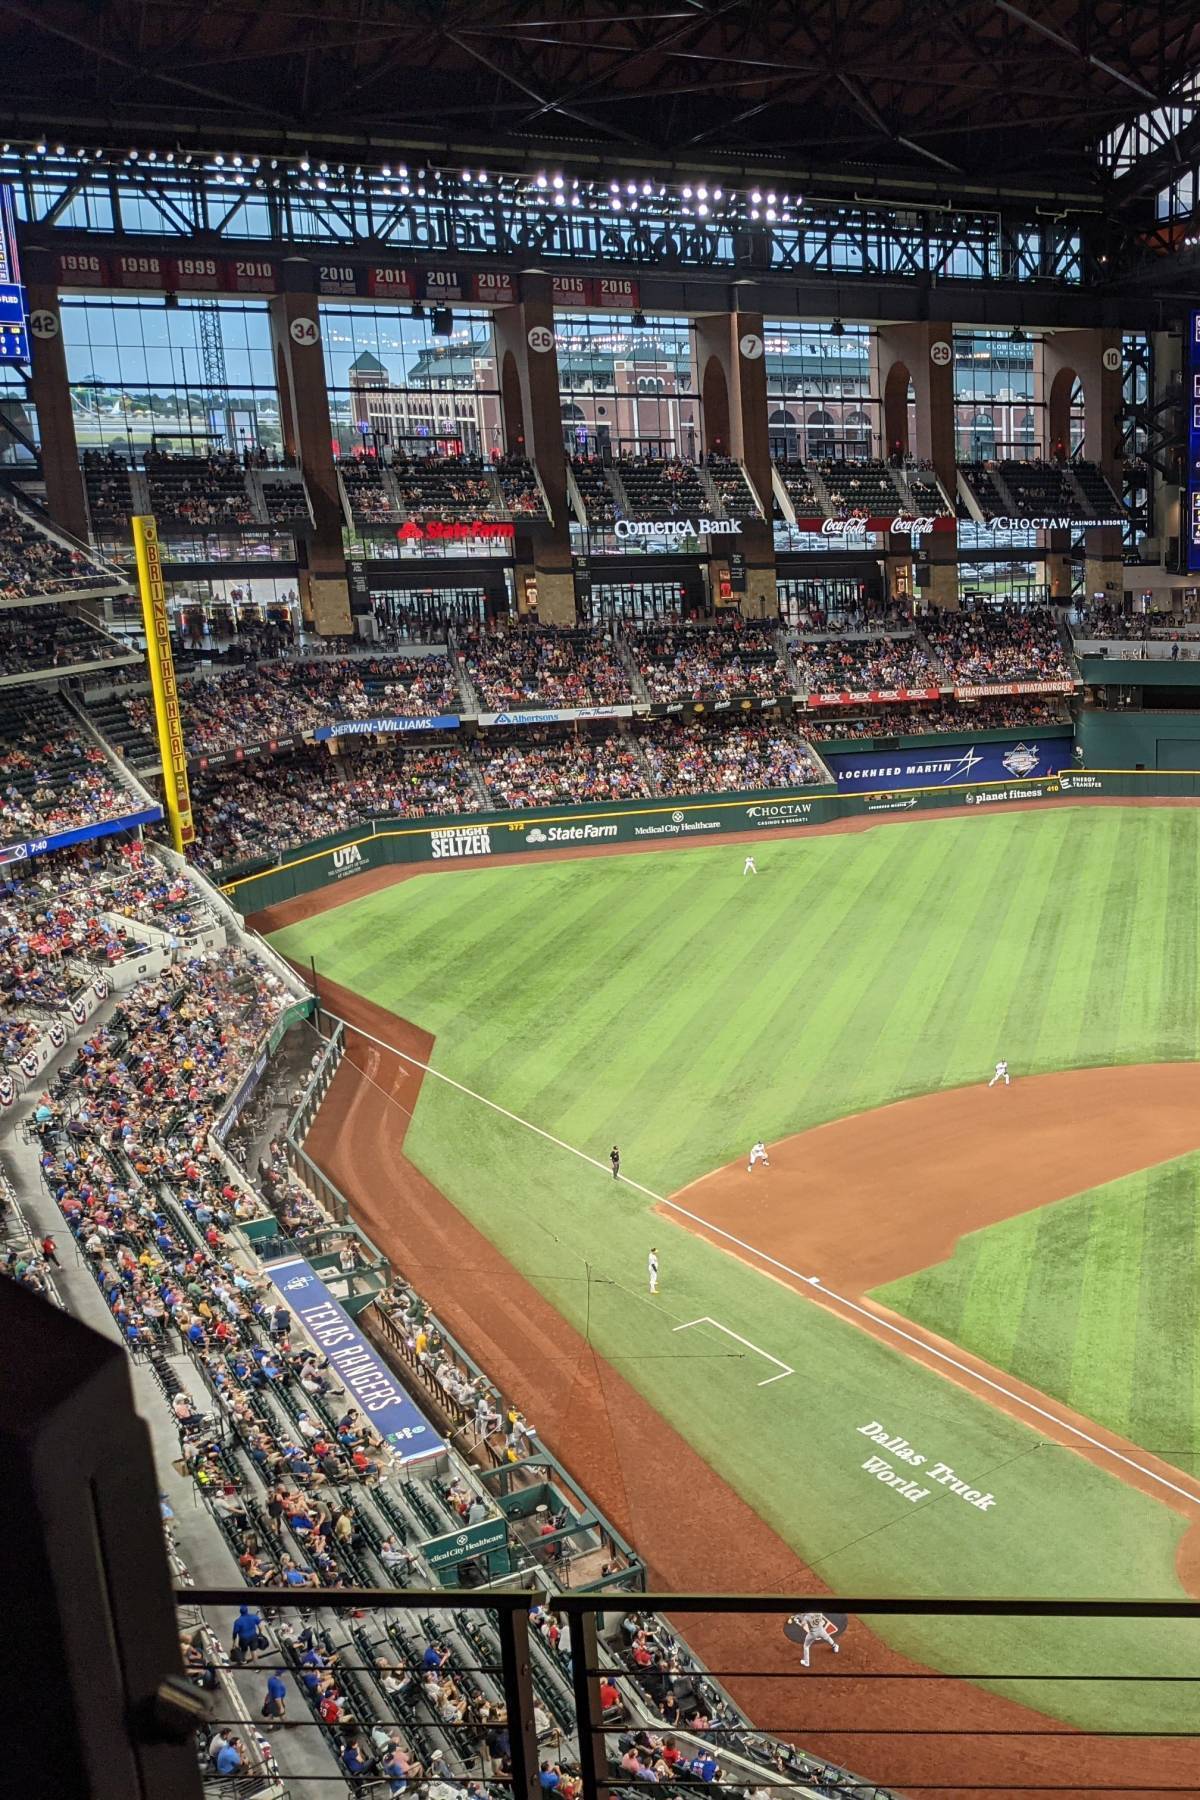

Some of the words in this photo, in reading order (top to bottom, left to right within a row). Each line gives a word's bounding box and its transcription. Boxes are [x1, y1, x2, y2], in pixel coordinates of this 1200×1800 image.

[61, 256, 99, 270] 1996
[122, 258, 160, 272] 1998
[177, 260, 216, 275] 1999
[236, 262, 272, 276] 2010
[320, 267, 354, 281] 2010
[376, 269, 406, 282] 2011
[427, 272, 457, 286] 2011
[479, 274, 510, 288] 2012
[553, 278, 583, 292] 2015
[601, 280, 632, 294] 2016
[31, 316, 55, 332] 42
[293, 323, 314, 339] 34
[531, 333, 550, 347] 26
[747, 340, 756, 353] 7
[933, 347, 949, 360] 29
[1106, 353, 1118, 366] 10
[426, 523, 468, 539] State
[472, 522, 515, 537] Farm
[699, 519, 742, 535] Bank
[821, 517, 869, 535] Coca-Cola
[890, 517, 936, 534] Coca-Cola
[998, 517, 1069, 530] CHOCTAW
[149, 547, 165, 635] BRING
[160, 645, 173, 695] THE
[820, 692, 840, 701] DEX
[849, 691, 870, 700] DEX
[878, 690, 899, 698] DEX
[906, 689, 926, 697] DEX
[958, 686, 1013, 697] WHATABURGER
[1017, 682, 1071, 693] WHATABURGER
[512, 714, 559, 723] Albertsons
[592, 707, 615, 716] Thumb
[168, 702, 183, 771] HEAT
[244, 747, 260, 755] TOYOTA
[209, 756, 226, 764] TOYOTA
[839, 767, 902, 780] LOCKHEED
[906, 763, 951, 774] MARTIN
[976, 792, 1008, 803] planet
[1009, 788, 1042, 799] fitness
[754, 804, 811, 816] CHOCTAW
[431, 830, 455, 839] BUD
[456, 827, 488, 837] LIGHT
[508, 823, 524, 831] 372
[635, 826, 664, 836] Medical
[665, 824, 679, 834] City
[680, 820, 721, 831] Healthcare
[30, 841, 47, 852] 7:40
[431, 835, 491, 858] SELTZER
[332, 845, 361, 868] UTA
[301, 1300, 354, 1357] TEXAS
[332, 1344, 400, 1413] RANGERS
[857, 1421, 928, 1468] Dallas
[927, 1462, 998, 1513] Truck
[861, 1456, 930, 1504] World
[450, 1543, 465, 1556] City
[466, 1534, 503, 1551] Healthcare
